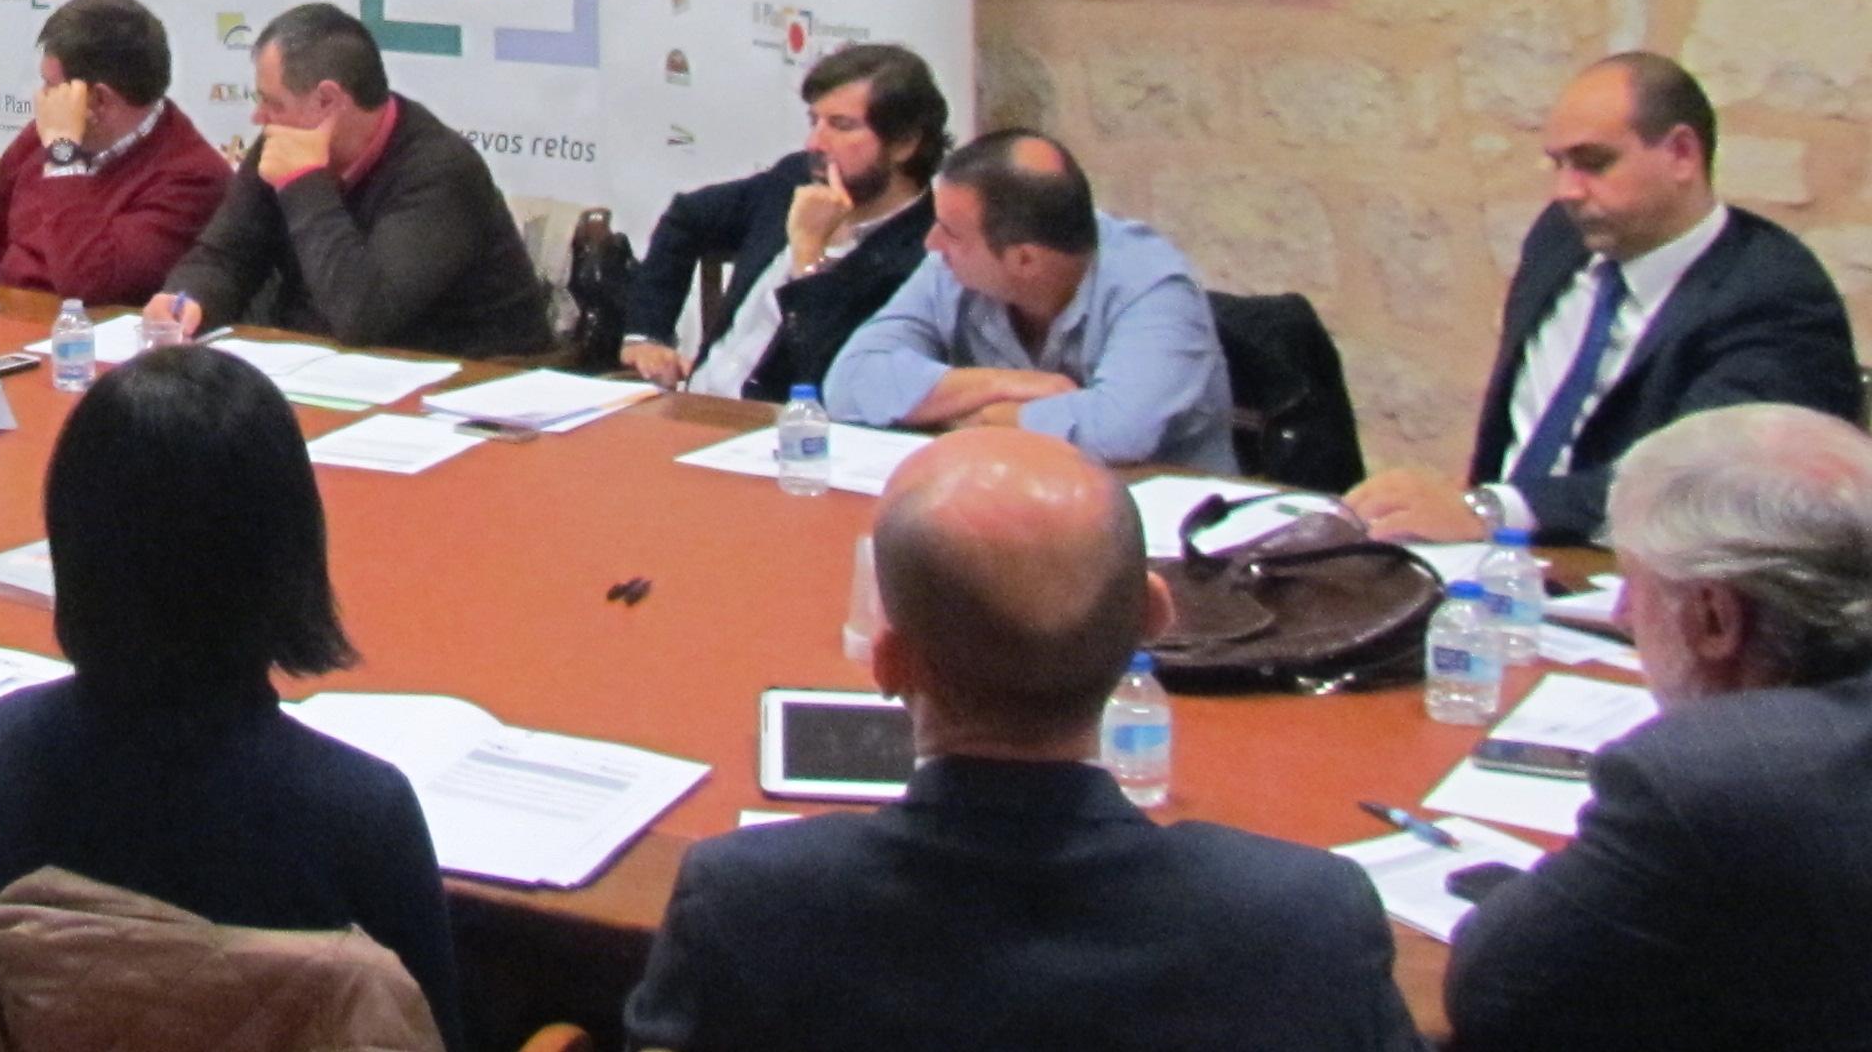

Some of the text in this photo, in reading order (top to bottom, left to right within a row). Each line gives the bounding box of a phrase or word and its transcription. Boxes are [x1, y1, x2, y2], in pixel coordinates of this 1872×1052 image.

[4, 94, 32, 114] Plan
[466, 130, 596, 163] evos retos
